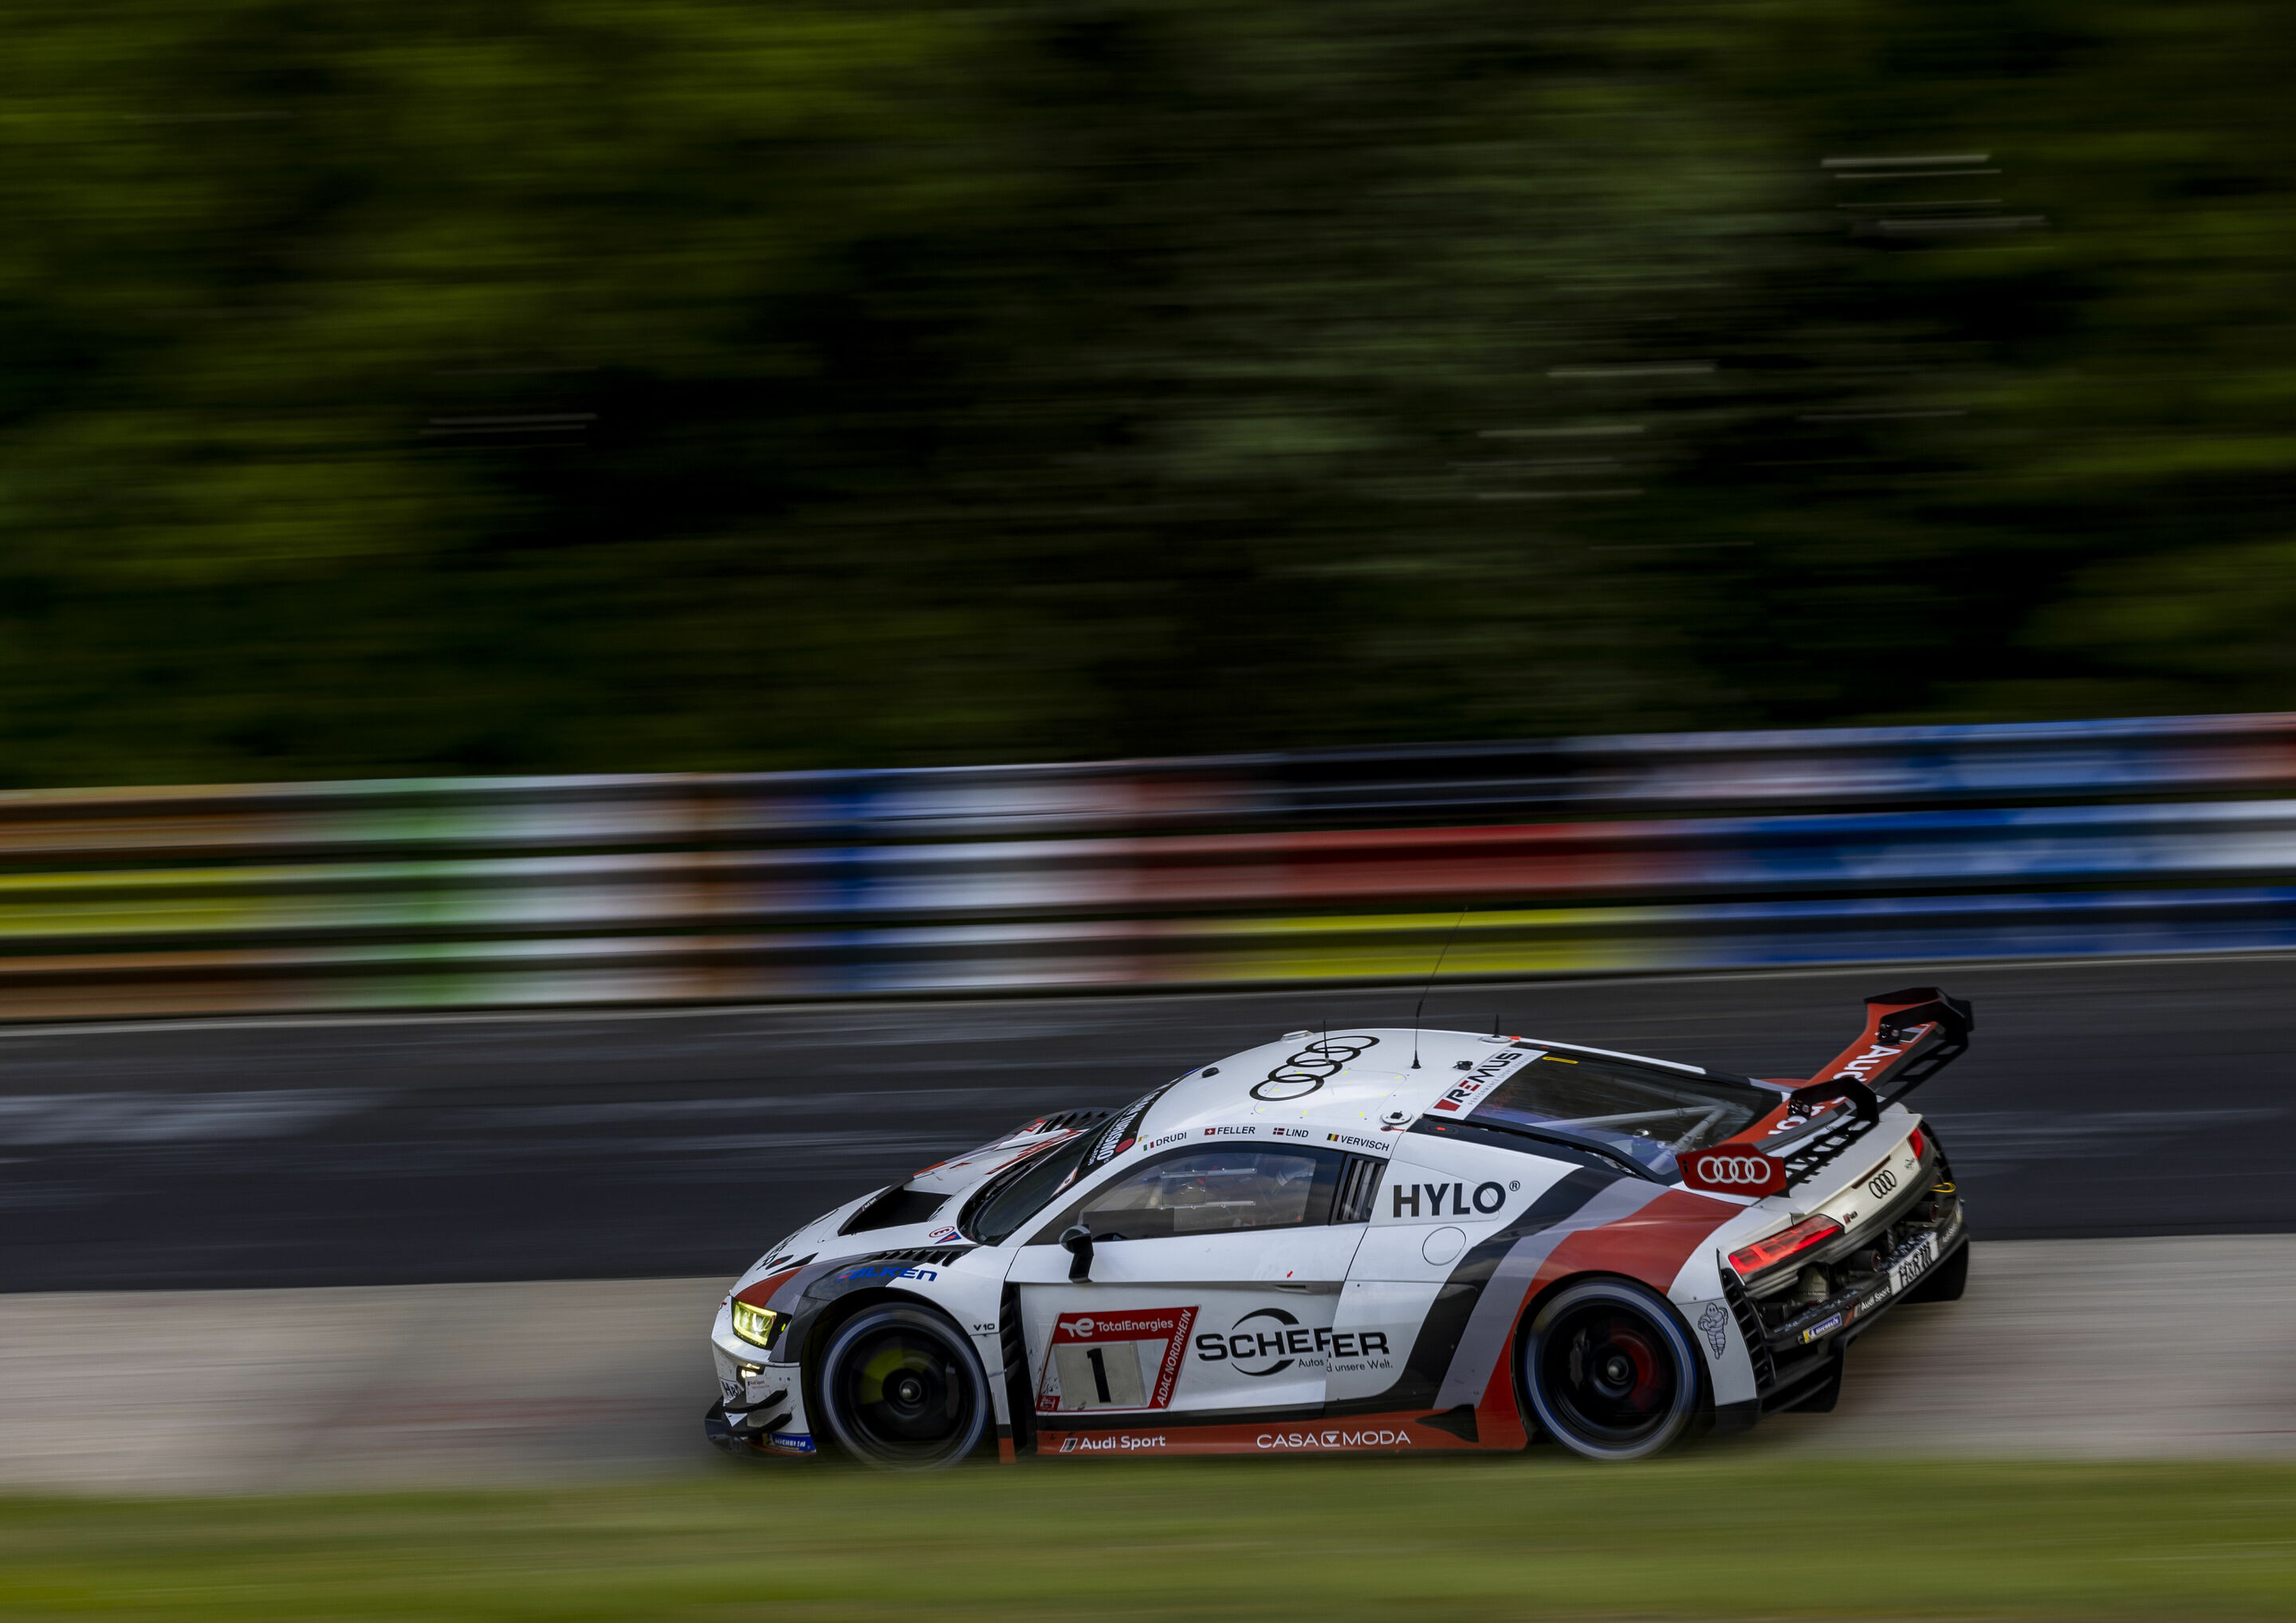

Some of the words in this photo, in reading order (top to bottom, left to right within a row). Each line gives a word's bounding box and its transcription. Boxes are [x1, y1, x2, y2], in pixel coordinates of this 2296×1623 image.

[1445, 1052, 1523, 1103] REMUS
[1097, 1112, 1138, 1161] TURISMO
[1217, 1126, 1256, 1135] FELLER
[1285, 1128, 1309, 1138] LIND
[1155, 1132, 1187, 1147] DRUDI
[1340, 1134, 1390, 1153] VERVISCH
[836, 1267, 938, 1283] FALKEN
[1861, 1295, 1875, 1311] Audi
[1874, 1286, 1890, 1302] Sport
[1096, 1318, 1174, 1332] TotalEnergies
[1157, 1373, 1173, 1406] ADAC
[1165, 1309, 1192, 1375] NORDRHEIN
[1298, 1358, 1324, 1368] Autos
[1335, 1363, 1366, 1372] unsere
[1366, 1358, 1394, 1370] Welt.
[1086, 1347, 1112, 1403] 1
[1080, 1436, 1117, 1450] Audi
[1120, 1434, 1166, 1451] Sport
[1256, 1433, 1315, 1448] CASA
[1342, 1430, 1412, 1446] MODA
